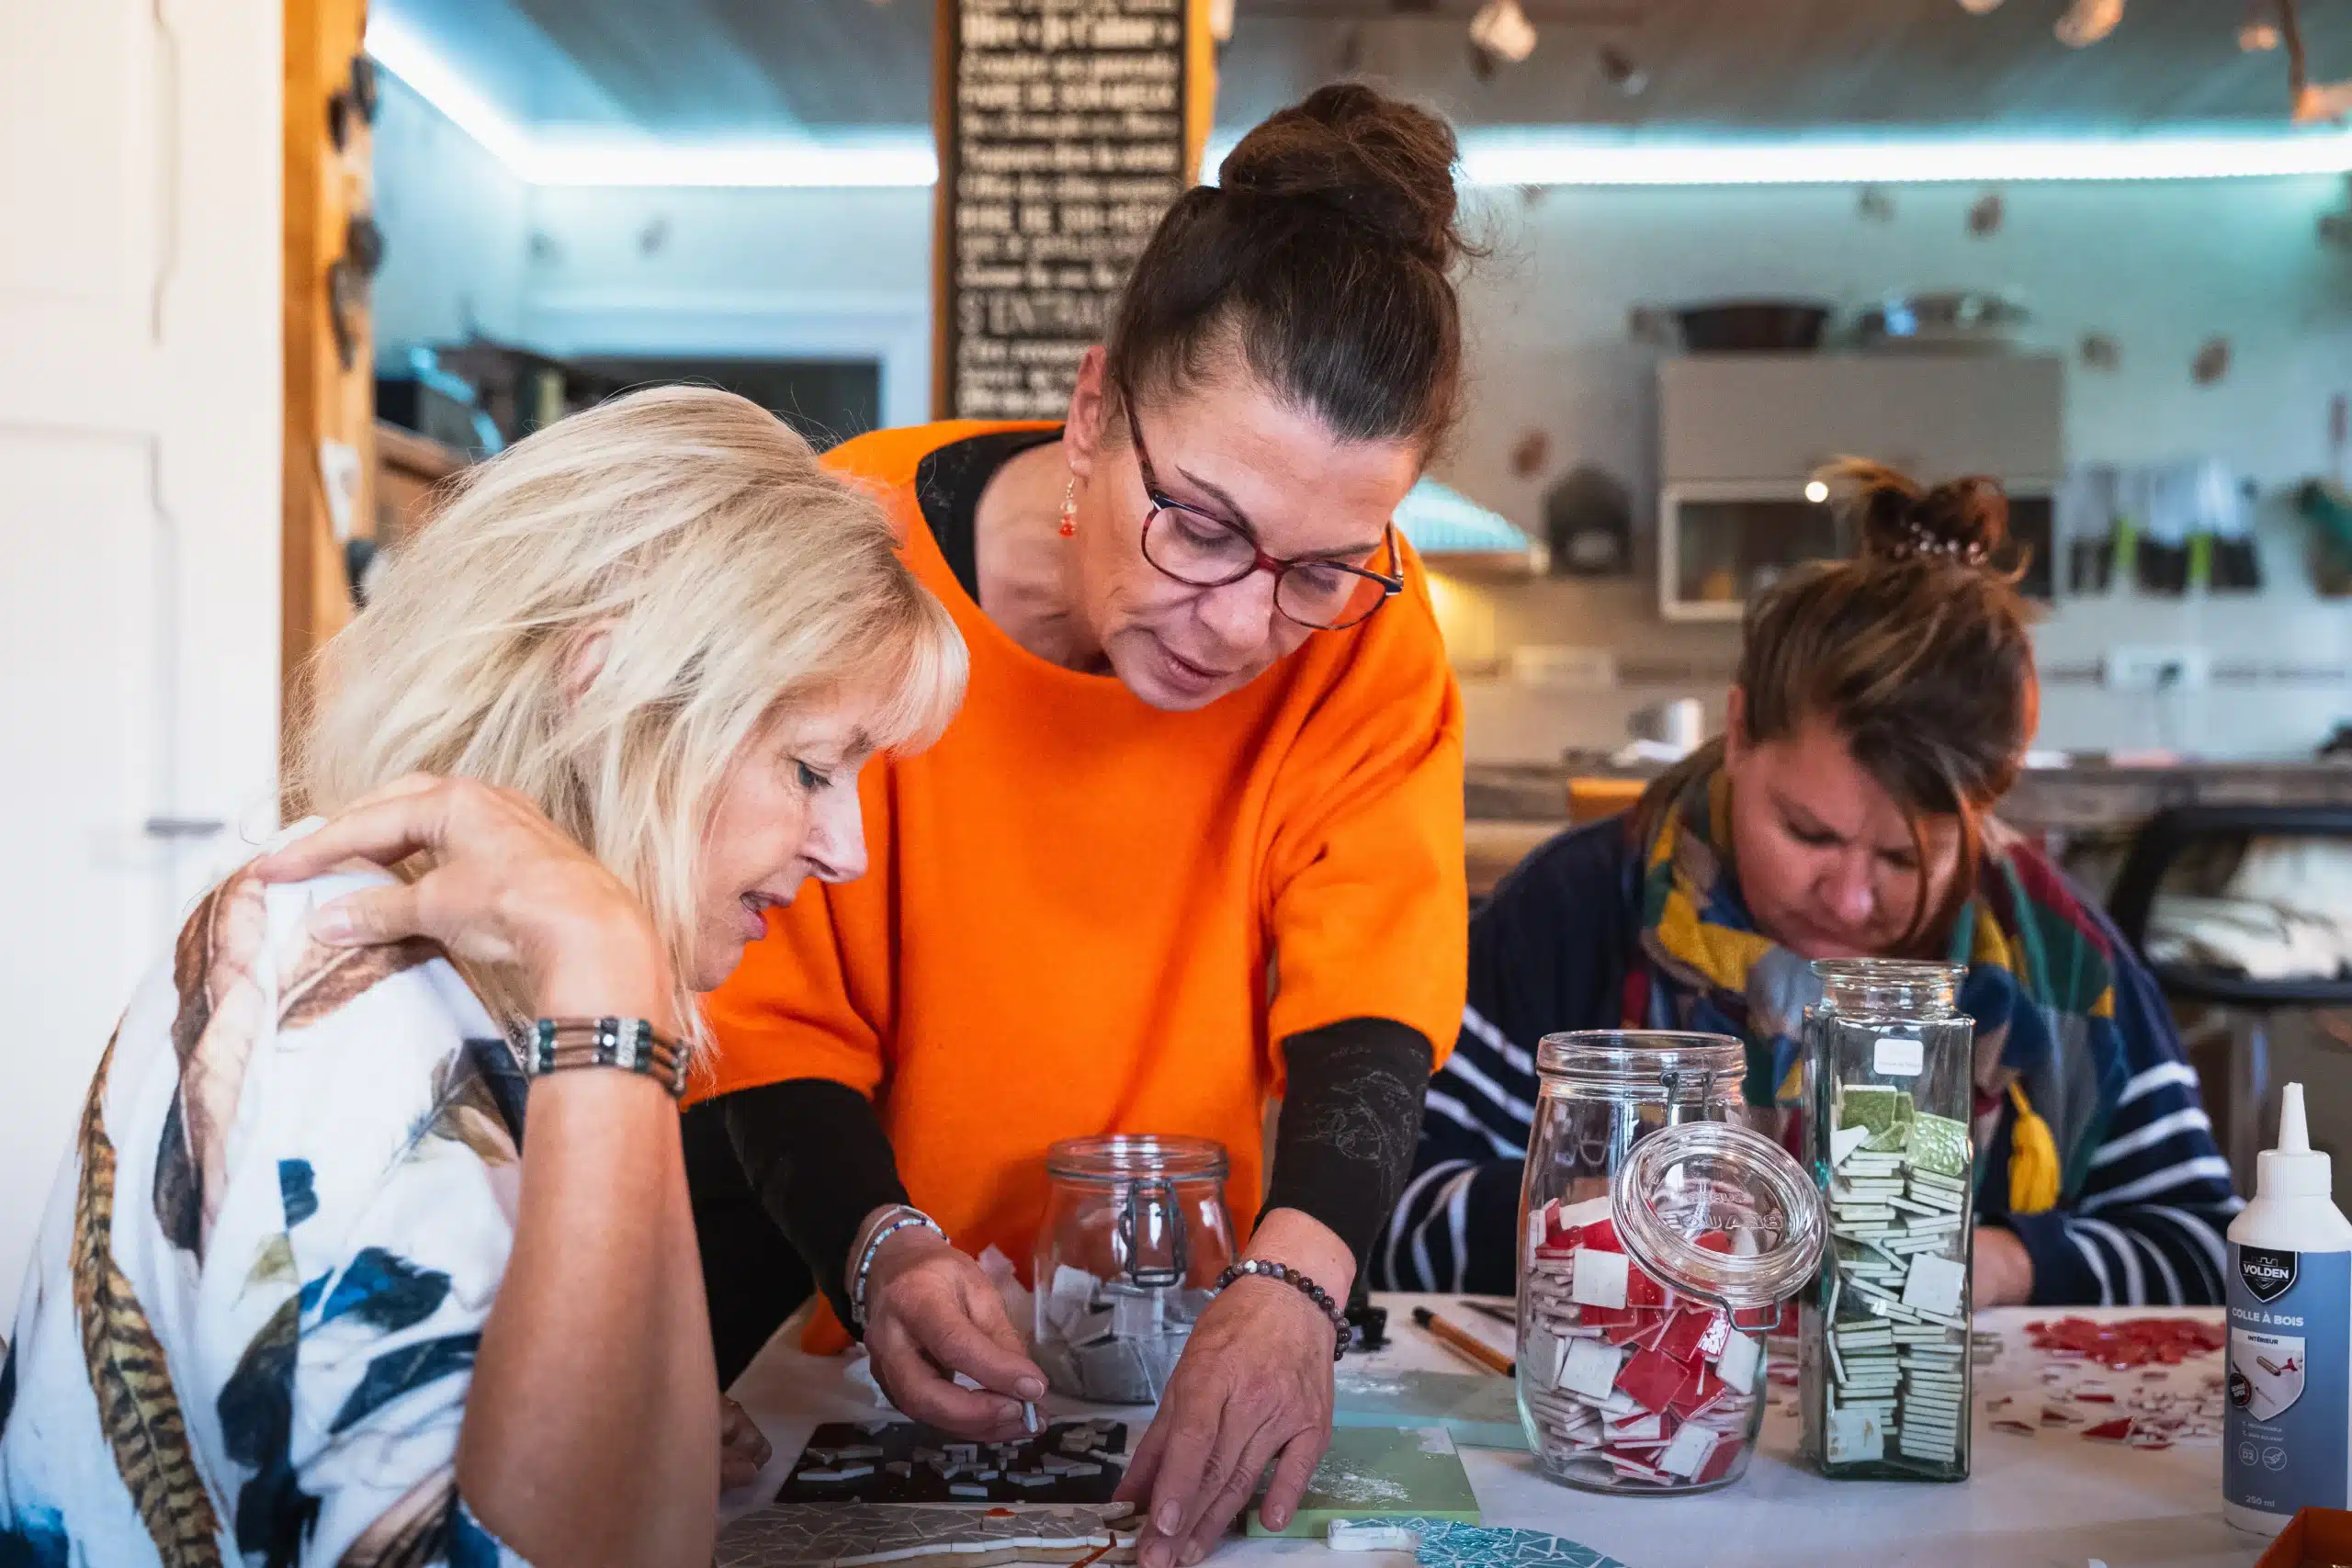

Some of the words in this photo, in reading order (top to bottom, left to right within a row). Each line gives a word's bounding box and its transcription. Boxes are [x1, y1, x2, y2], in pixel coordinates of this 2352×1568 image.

[2244, 1264, 2289, 1279] VOLDEN
[2232, 1307, 2260, 1323] COLLE
[2262, 1310, 2271, 1324] À
[2273, 1314, 2304, 1327] BOIS
[2247, 1335, 2278, 1345] INTÉRIEUR
[2242, 1450, 2254, 1461] D2
[2245, 1495, 2262, 1505] 250
[2263, 1499, 2276, 1507] ml
